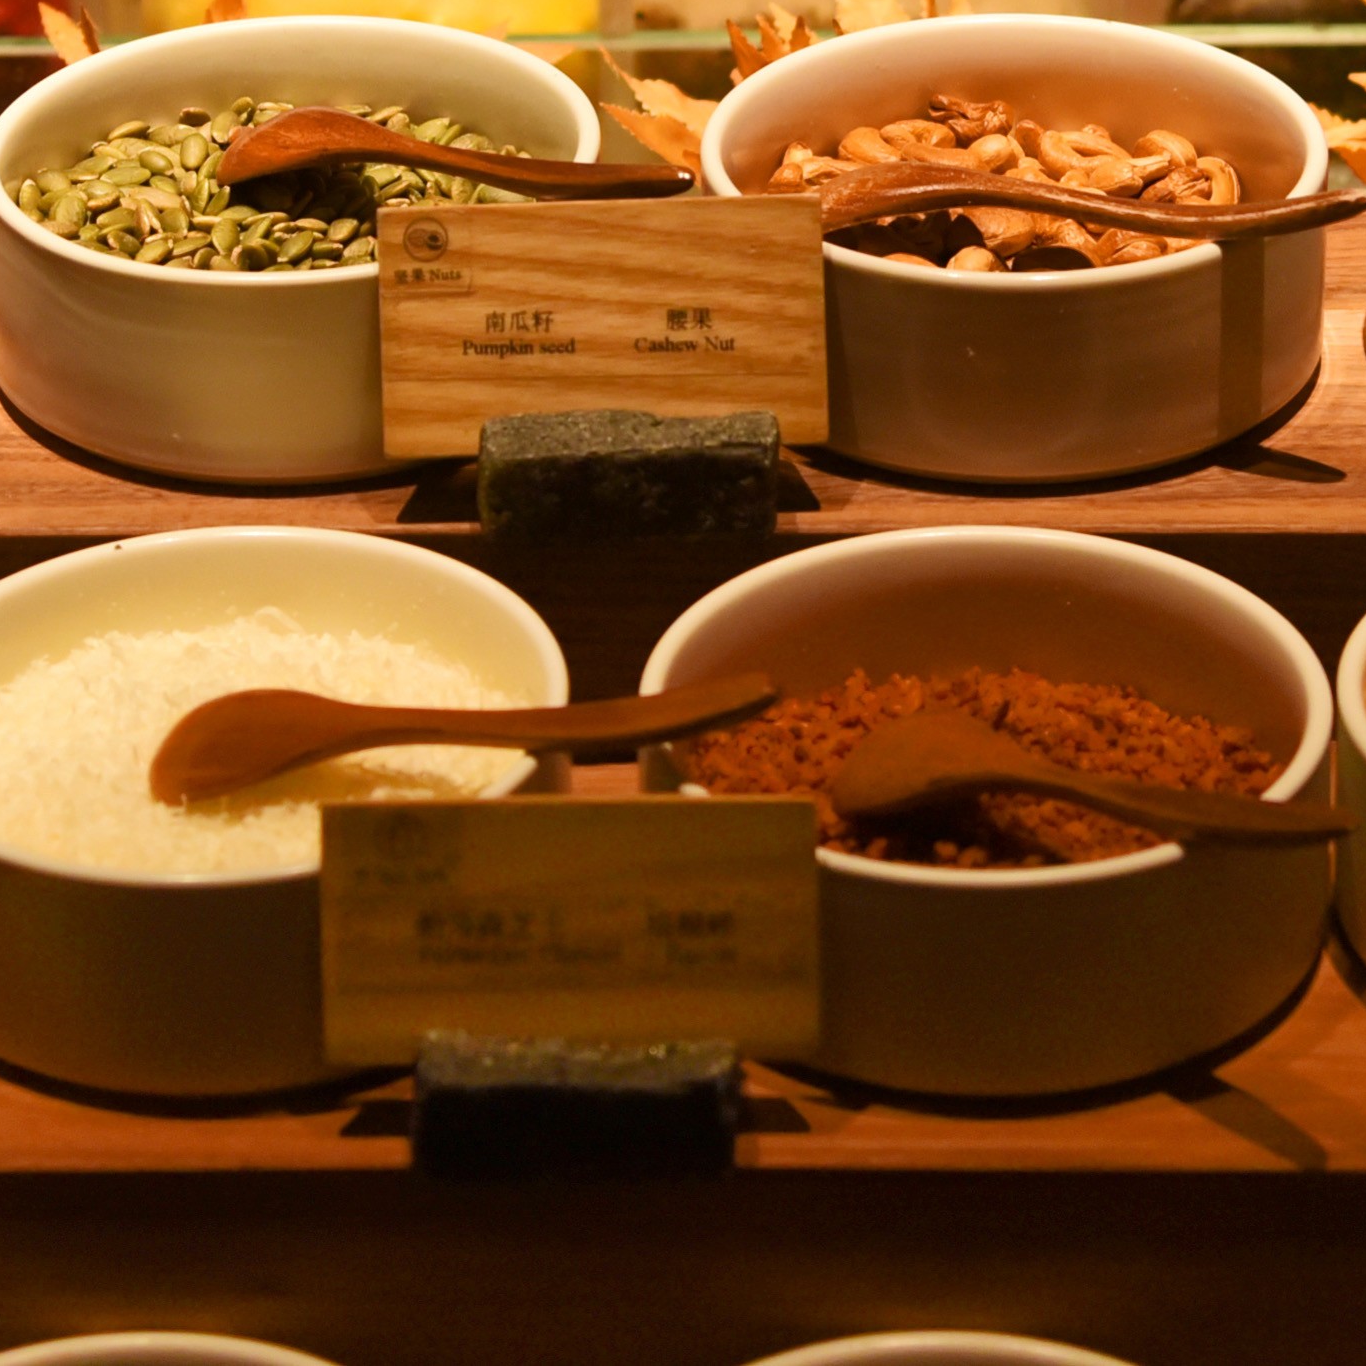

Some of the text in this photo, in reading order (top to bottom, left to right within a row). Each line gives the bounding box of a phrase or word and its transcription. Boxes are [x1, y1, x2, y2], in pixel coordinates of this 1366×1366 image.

[429, 268, 463, 281] Nuts
[485, 310, 554, 334] 南瓜籽
[666, 308, 713, 331] 腰果
[462, 338, 576, 359] Pumpkin seed
[634, 336, 735, 354] Cashew Nut
